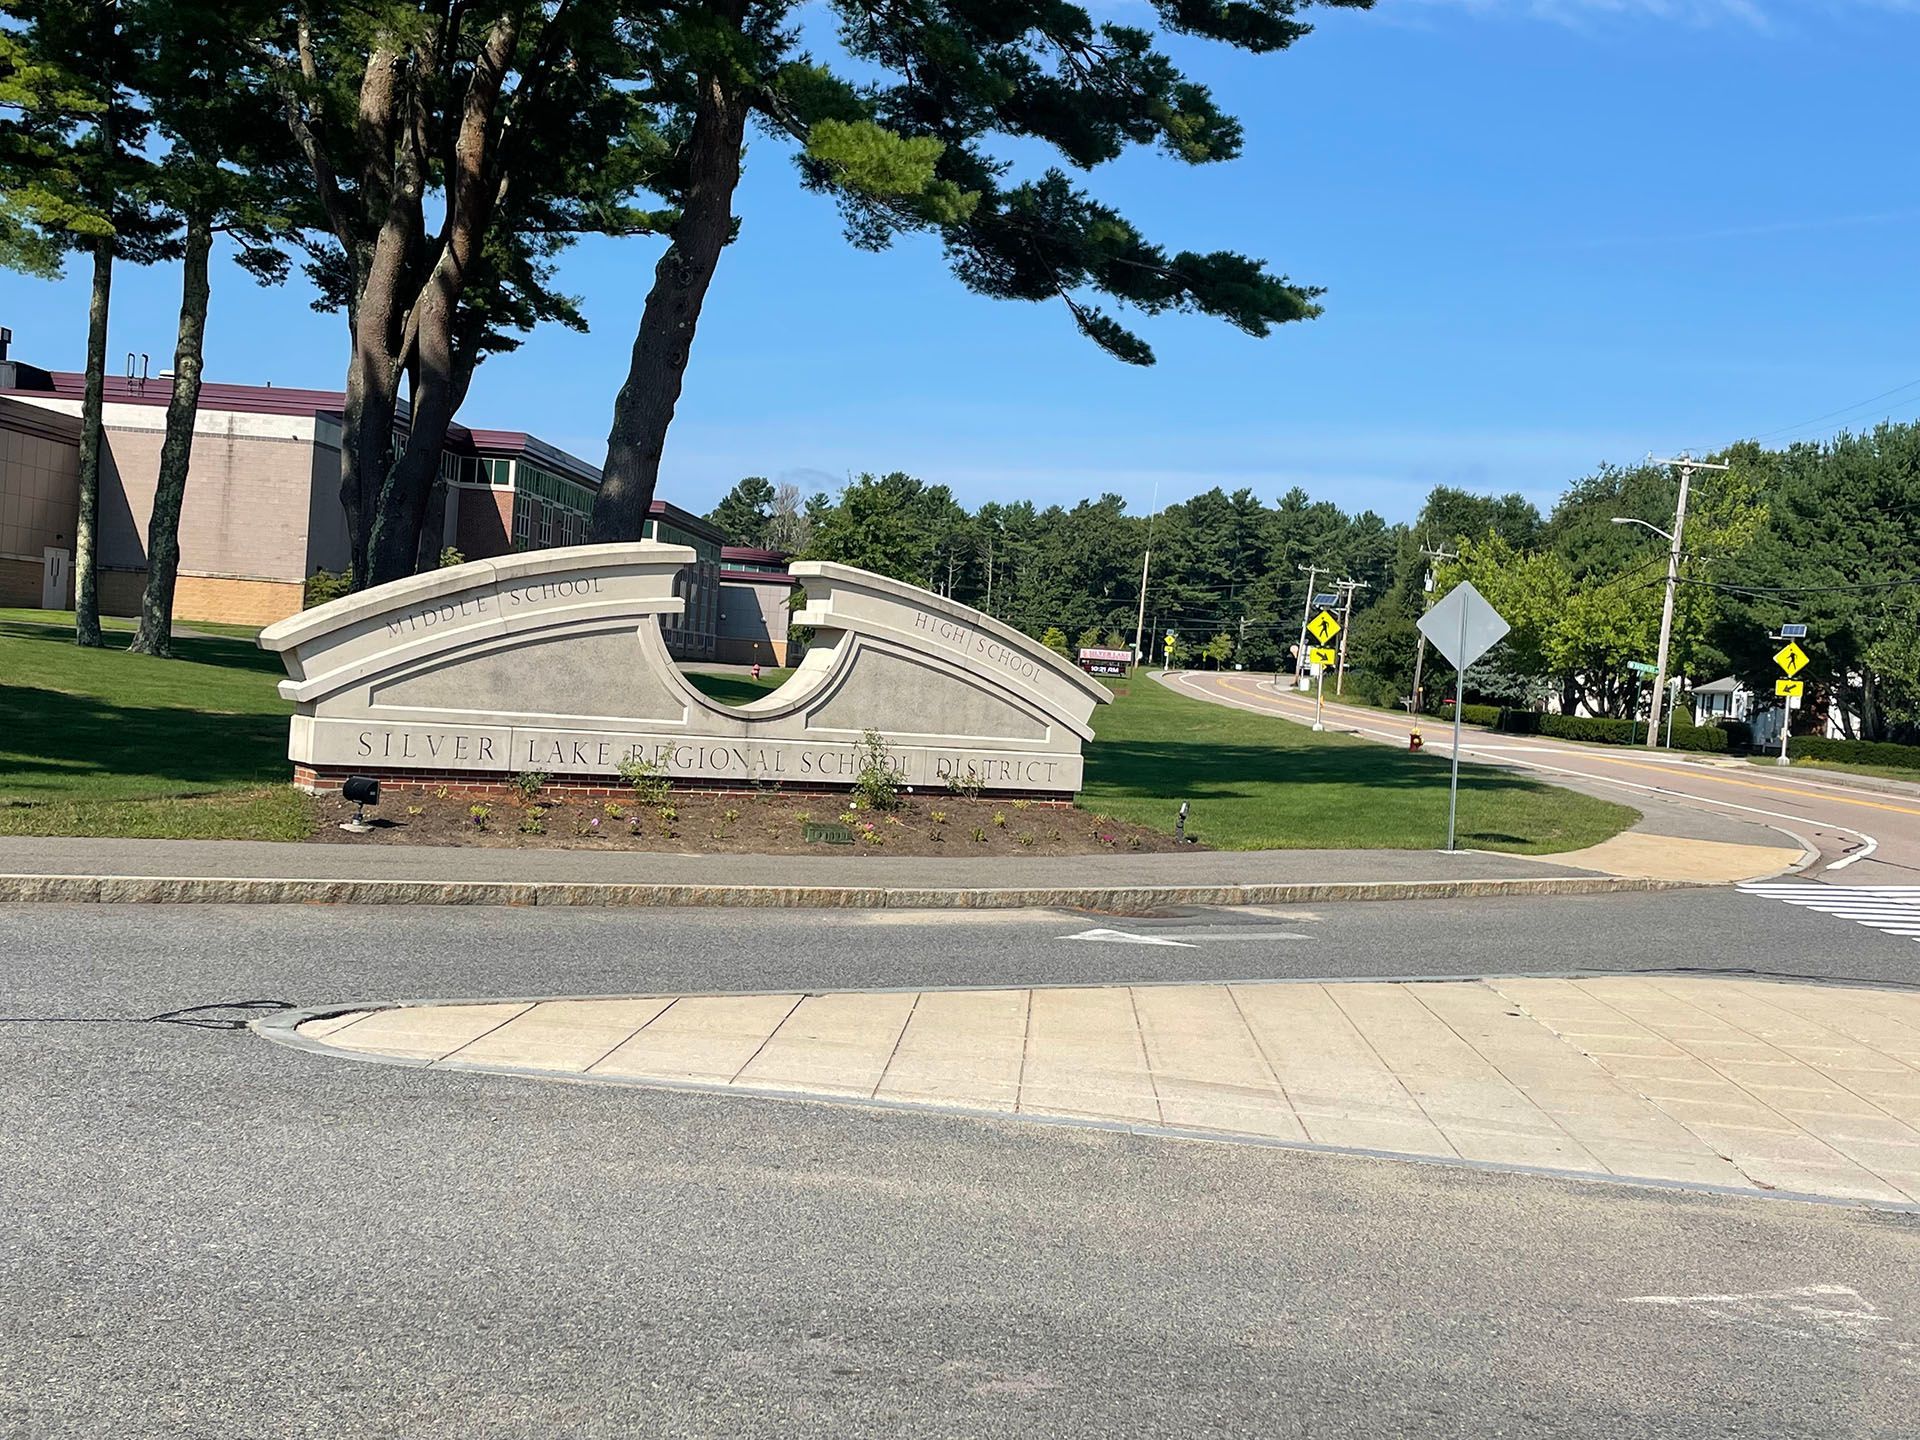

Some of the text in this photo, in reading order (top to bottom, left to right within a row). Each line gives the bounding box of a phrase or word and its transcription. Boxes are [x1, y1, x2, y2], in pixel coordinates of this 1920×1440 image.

[386, 577, 603, 638] MIDDLE SCHOOL
[914, 612, 1042, 682] HIGH SCHOOL
[357, 731, 494, 761] SILVER
[528, 739, 610, 766] LAKE
[630, 744, 786, 772] REGIONAL
[936, 757, 1058, 783] DISTRICT
